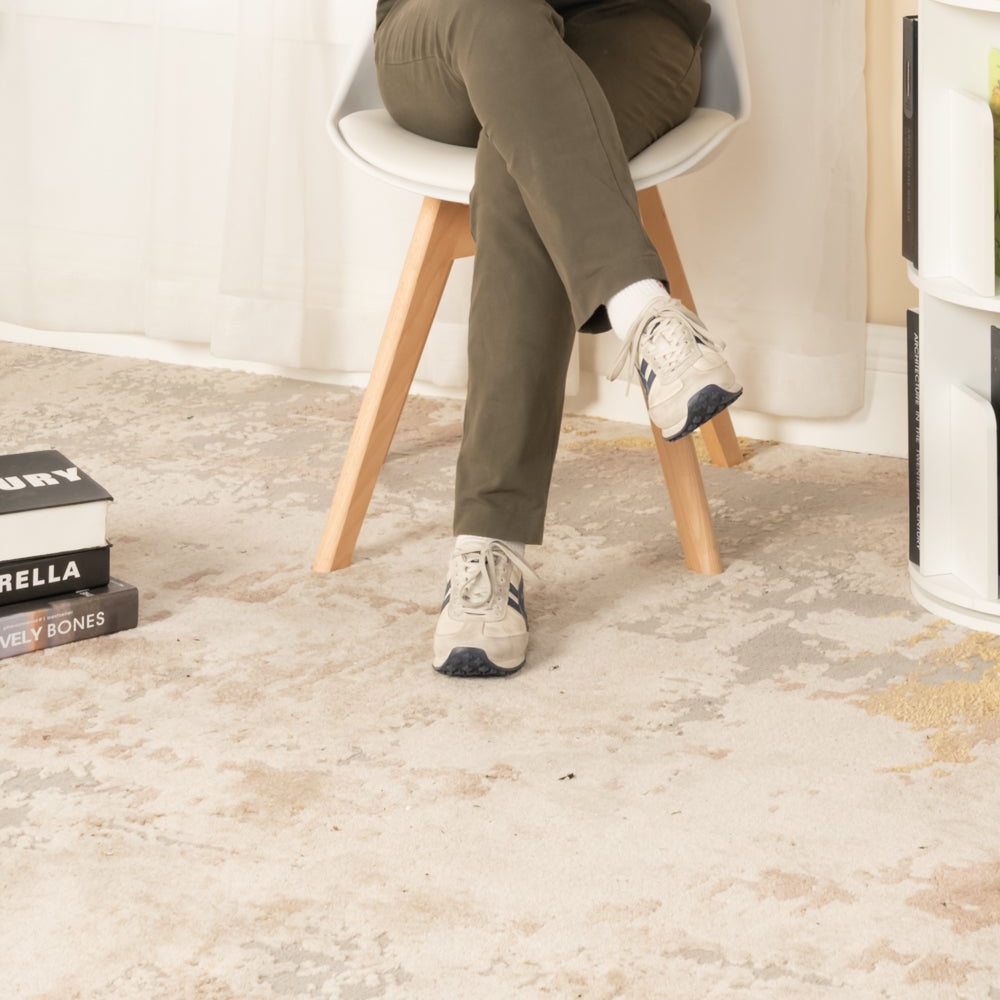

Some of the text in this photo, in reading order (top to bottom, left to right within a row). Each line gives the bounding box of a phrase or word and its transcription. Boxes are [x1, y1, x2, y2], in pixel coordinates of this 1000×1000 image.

[0, 467, 81, 491] URY
[0, 560, 81, 593] RELLA
[0, 611, 105, 649] VELY BONES
